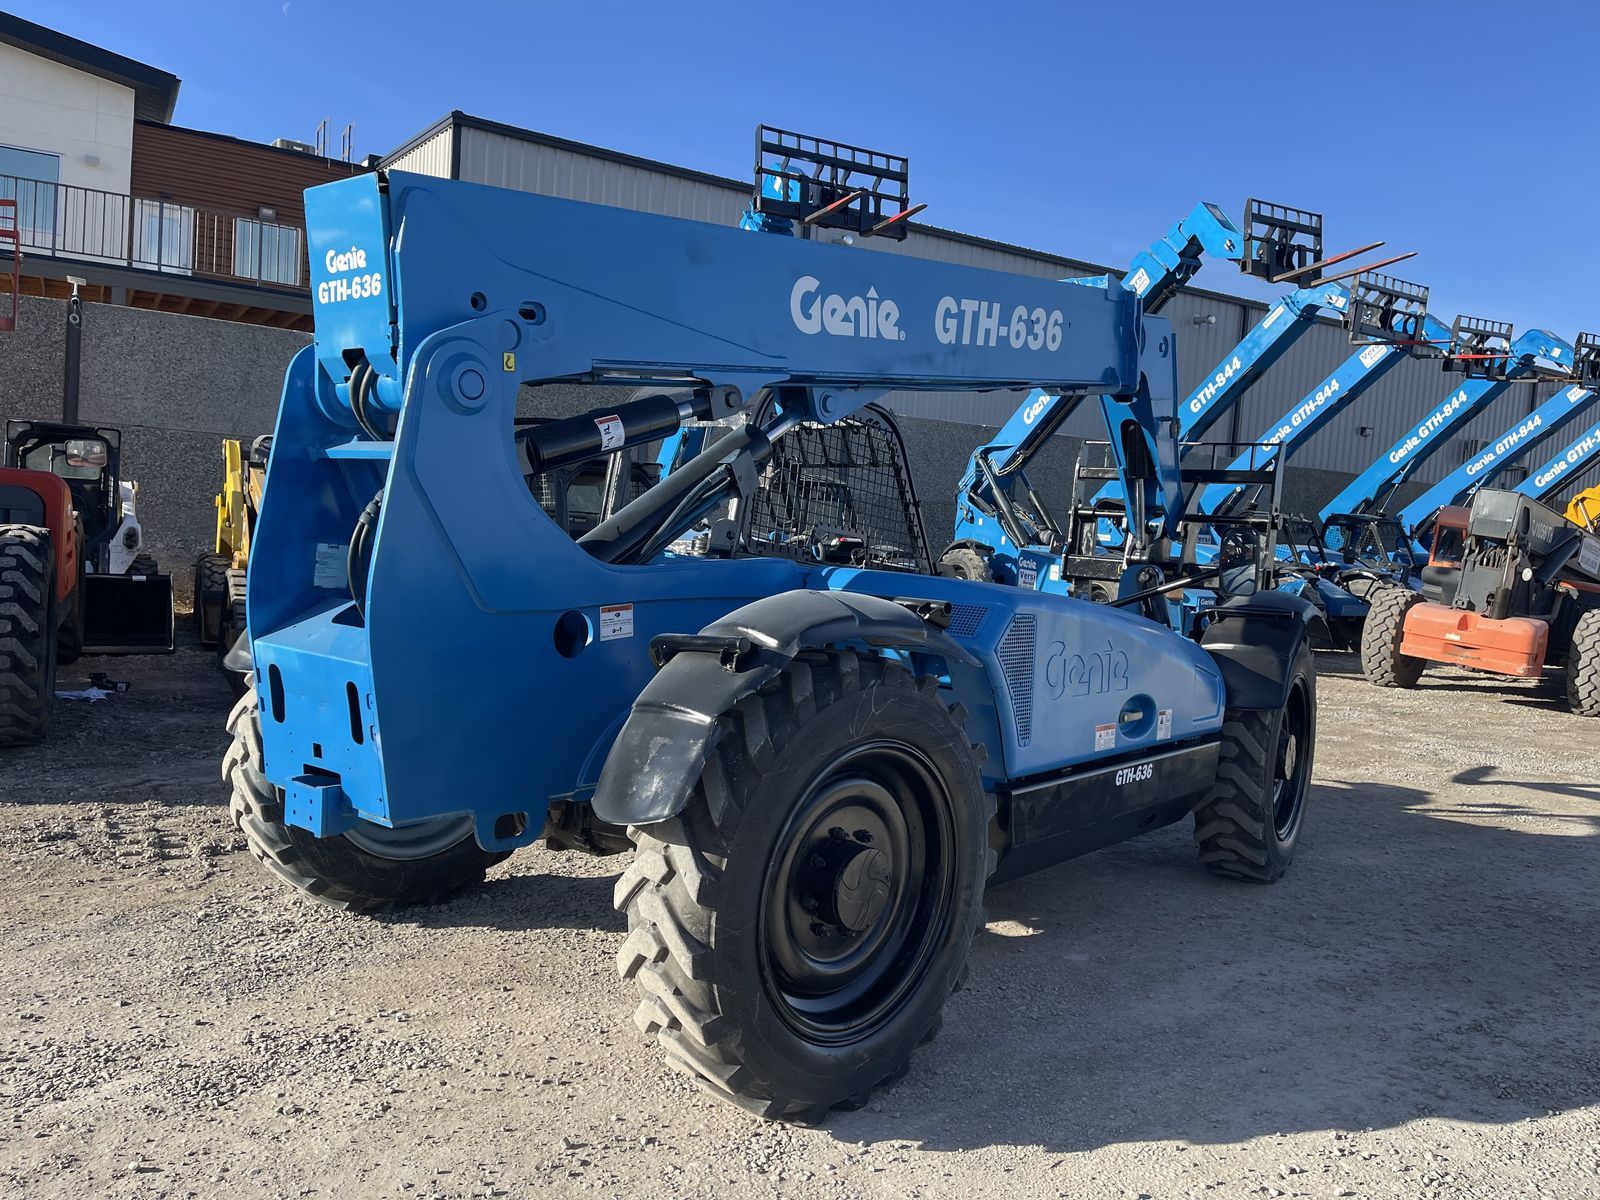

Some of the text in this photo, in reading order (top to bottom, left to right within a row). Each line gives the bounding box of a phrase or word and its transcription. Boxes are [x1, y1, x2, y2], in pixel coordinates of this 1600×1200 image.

[318, 272, 382, 305] GTH-636
[325, 245, 367, 274] Genie
[790, 275, 1064, 352] Genie GTH-636
[1190, 355, 1242, 413] GTH-844
[1261, 378, 1340, 452] Genie GTH-844
[1389, 389, 1468, 464] Genie GTH-844
[1466, 414, 1542, 476] Genie GTH-844
[1534, 460, 1568, 488] Genie
[1018, 556, 1037, 570] Genie
[1046, 640, 1129, 701] Genie
[1115, 763, 1153, 786] GTH-636
